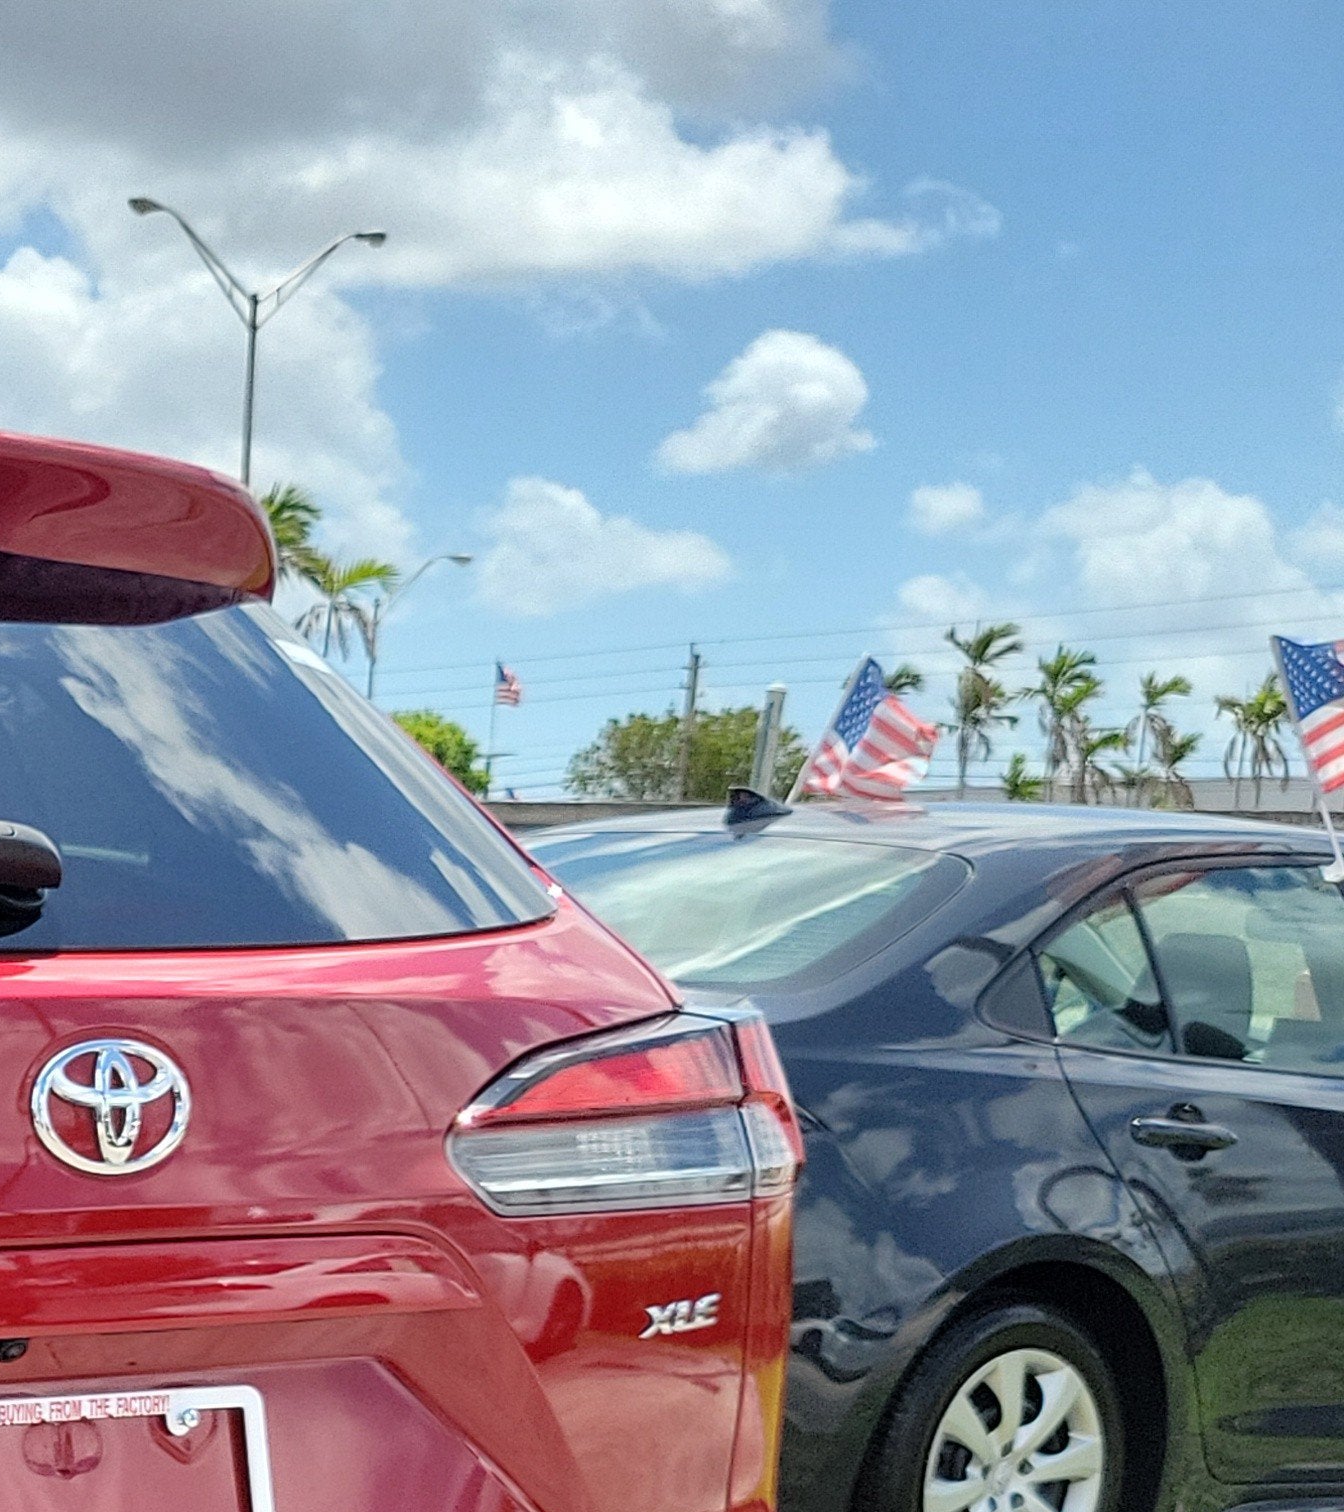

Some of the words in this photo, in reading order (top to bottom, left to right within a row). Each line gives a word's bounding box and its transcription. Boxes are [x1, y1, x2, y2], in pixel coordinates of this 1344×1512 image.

[638, 1292, 722, 1340] XLE
[49, 1400, 83, 1420] FROM
[89, 1398, 111, 1416] THE
[116, 1394, 171, 1415] FACTORY!
